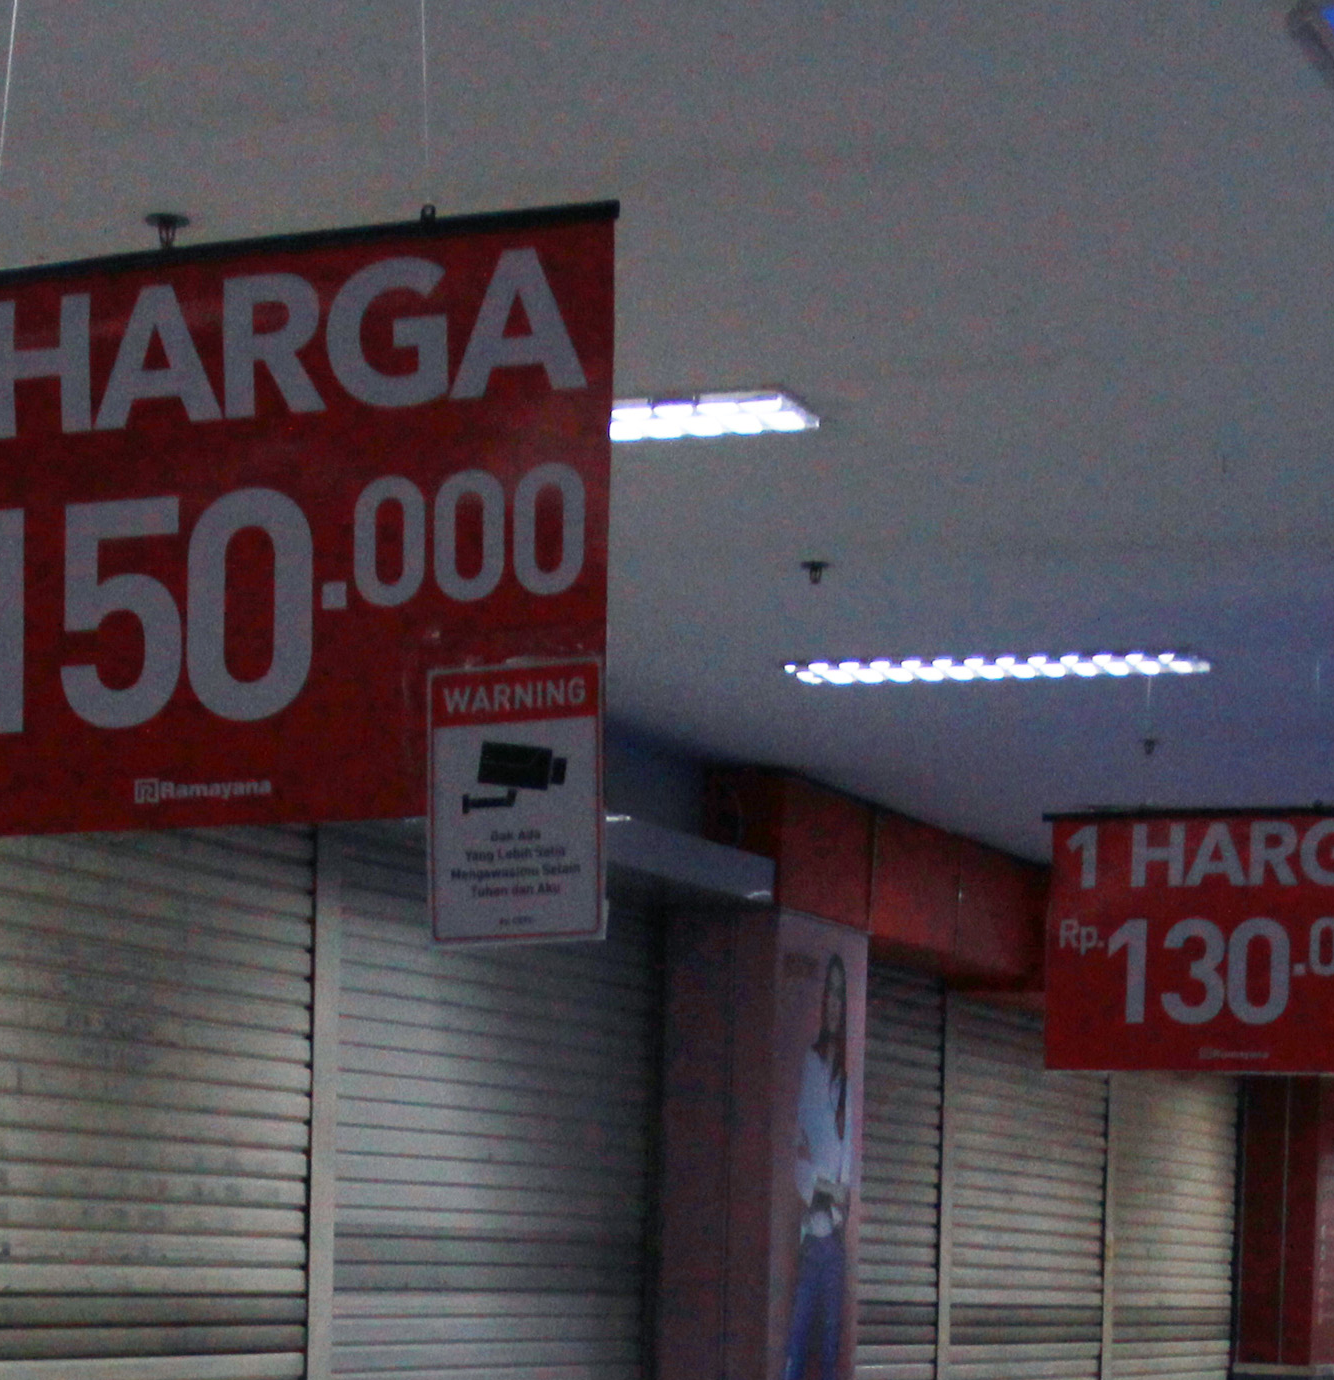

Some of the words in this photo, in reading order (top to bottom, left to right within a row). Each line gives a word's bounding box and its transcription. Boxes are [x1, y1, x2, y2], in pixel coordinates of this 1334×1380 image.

[443, 677, 587, 715] WARNING
[160, 779, 272, 801] Ramayana
[1068, 825, 1098, 890] 1
